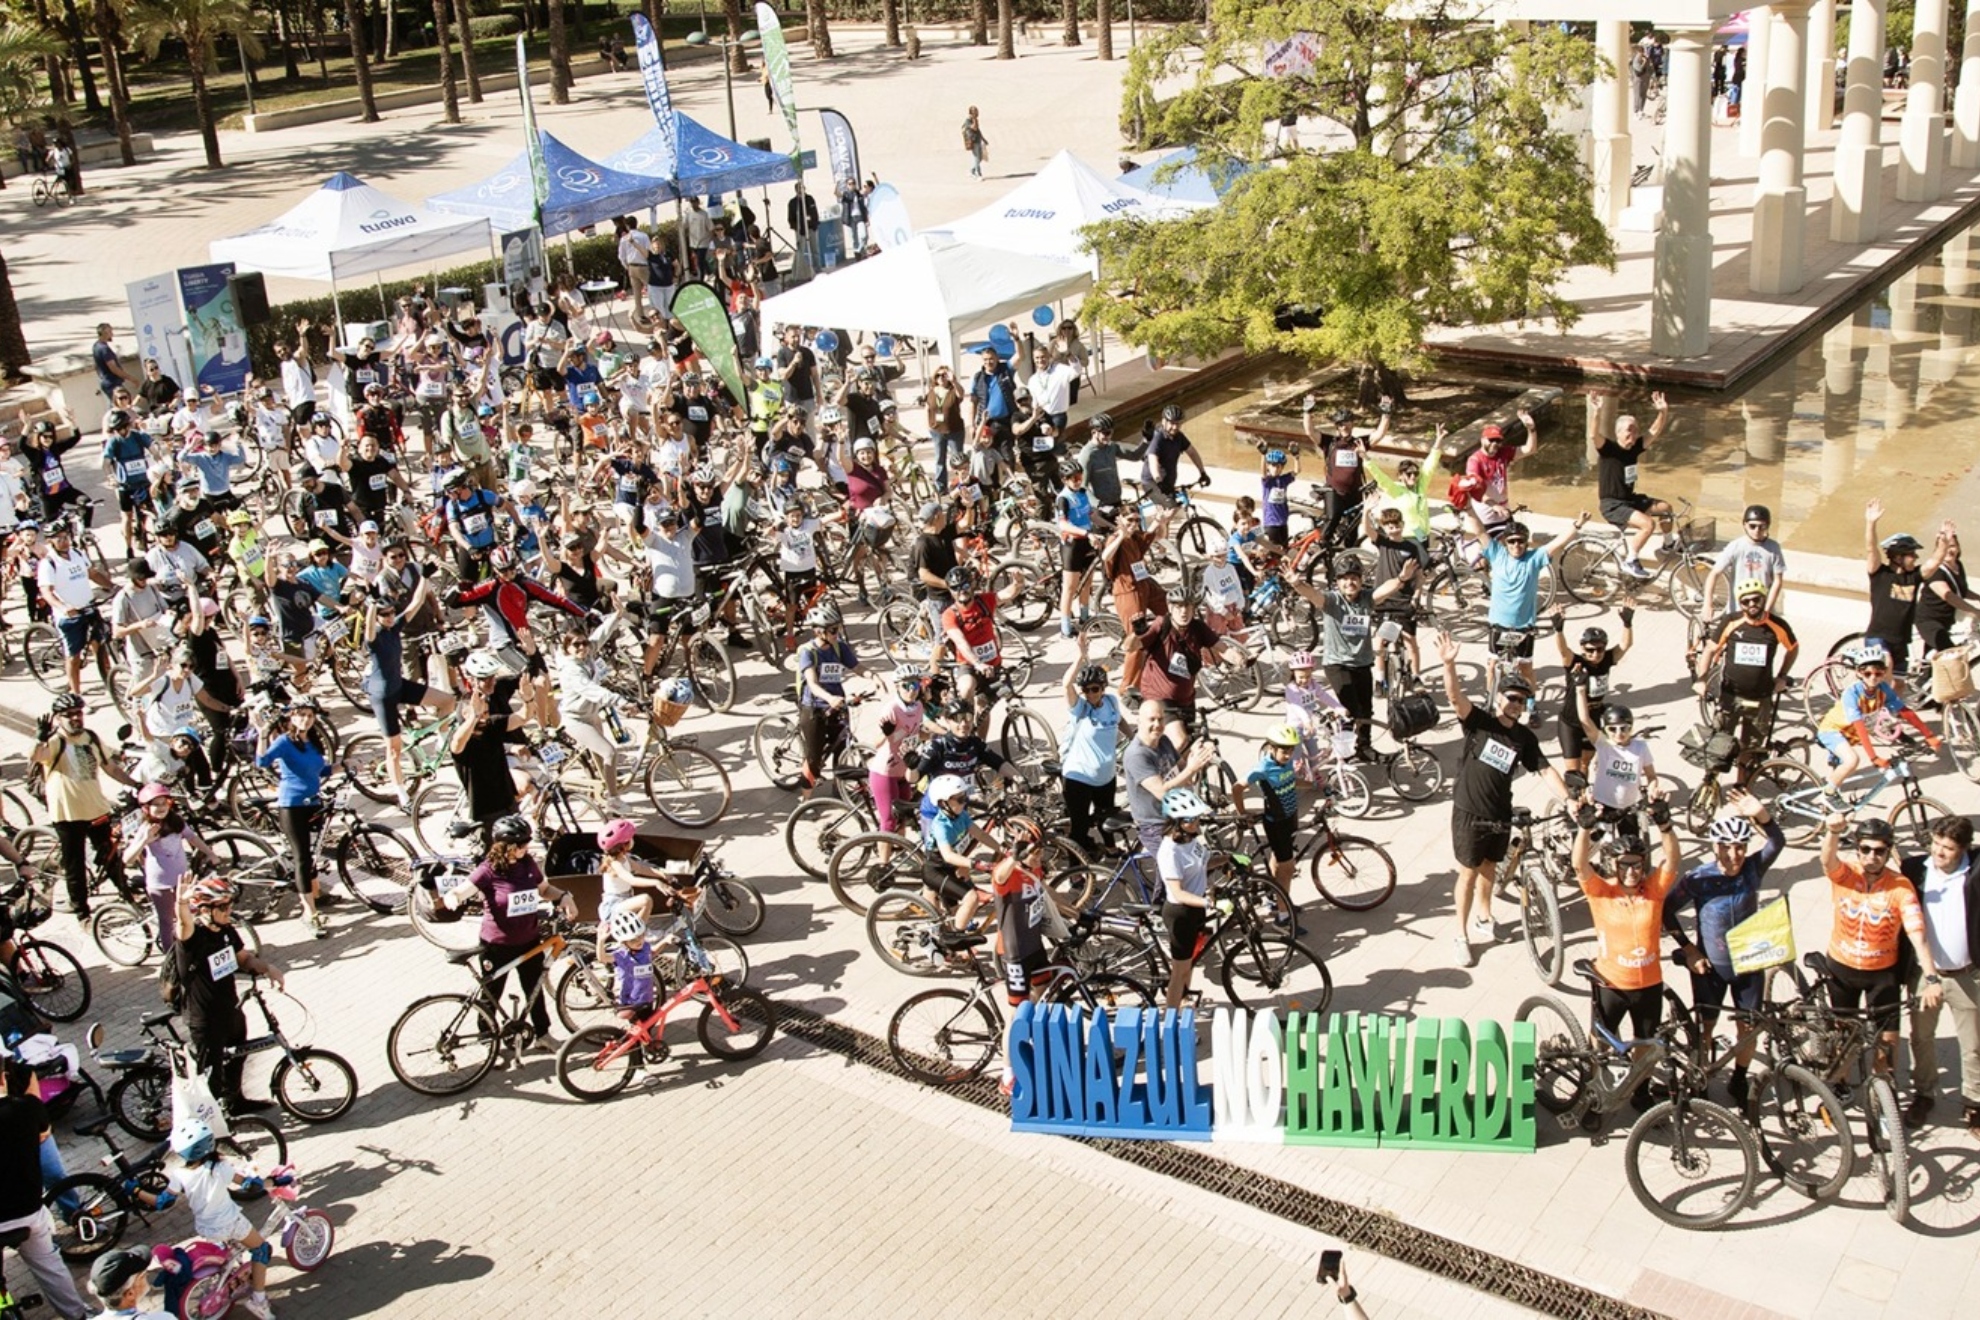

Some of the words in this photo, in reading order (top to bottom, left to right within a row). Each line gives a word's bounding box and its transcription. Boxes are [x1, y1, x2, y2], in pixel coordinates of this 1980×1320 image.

[1004, 208, 1056, 220] tuawa
[360, 213, 417, 234] tuawa
[1346, 616, 1364, 625] 104
[1741, 645, 1762, 656] 001
[1490, 744, 1510, 761] 001
[1612, 759, 1634, 772] 001
[512, 891, 535, 906] 096
[213, 950, 231, 967] 097
[1007, 963, 1026, 992] BH
[1212, 1007, 1283, 1130] NO
